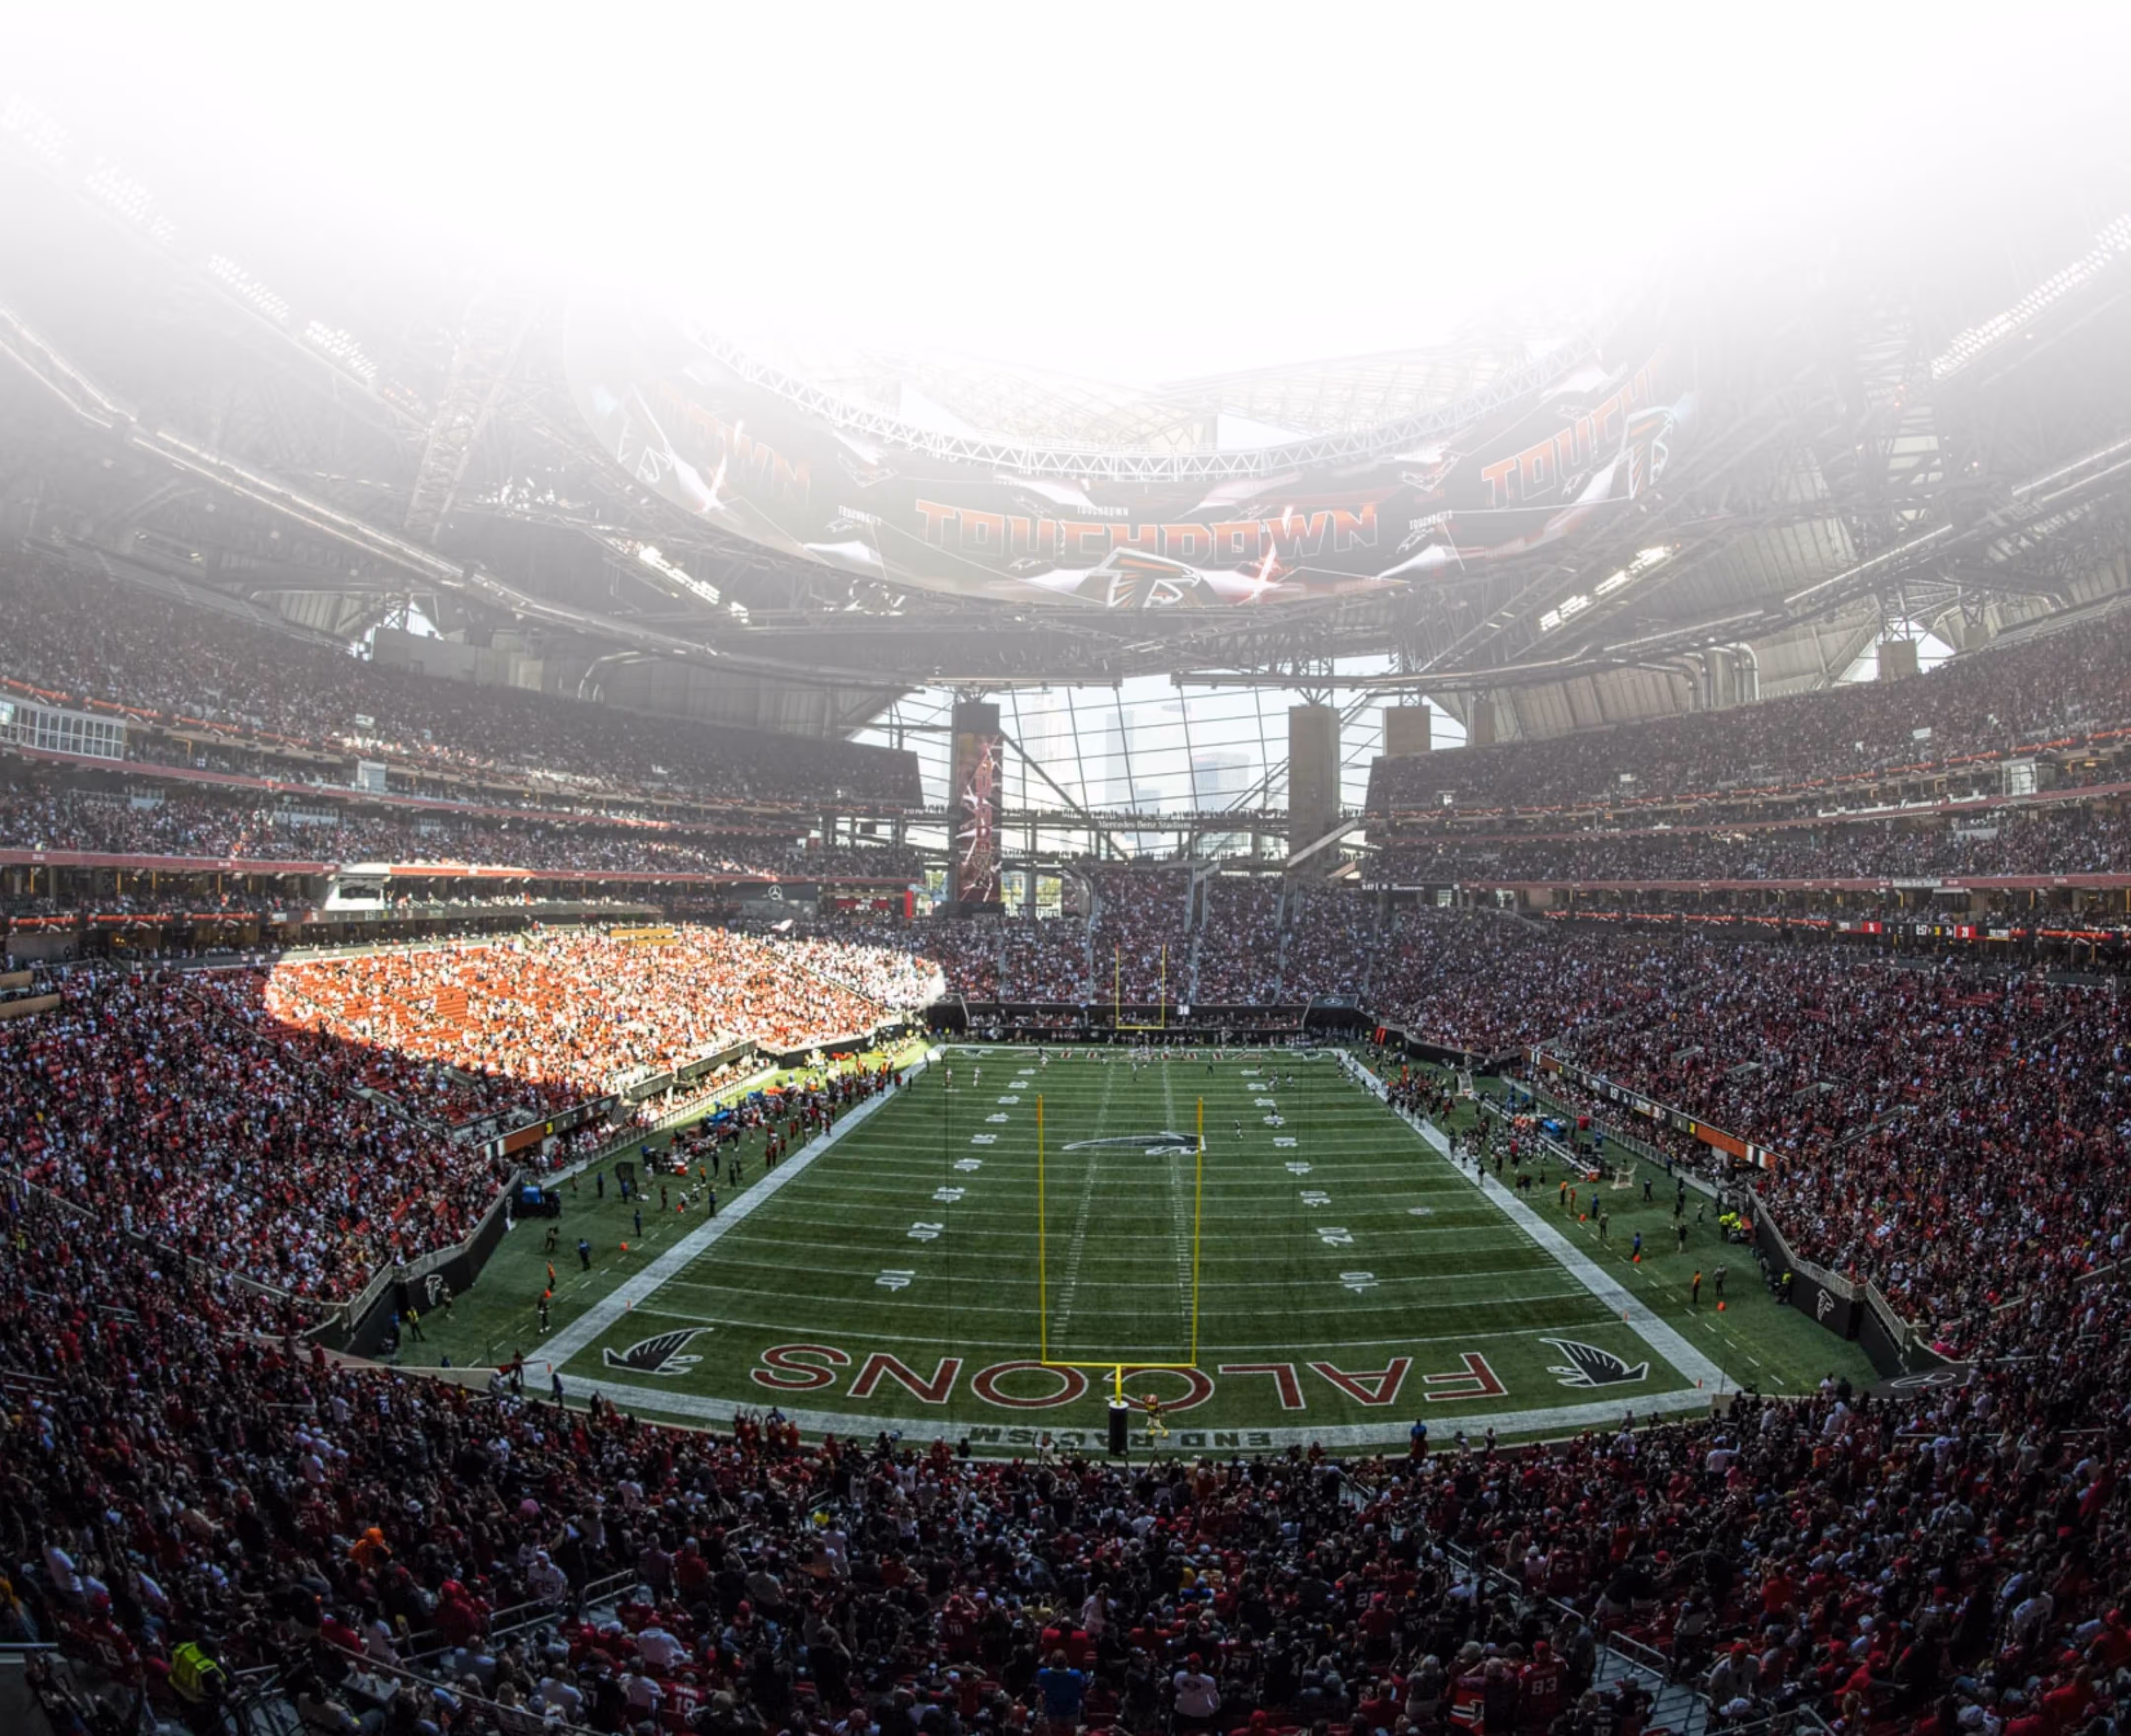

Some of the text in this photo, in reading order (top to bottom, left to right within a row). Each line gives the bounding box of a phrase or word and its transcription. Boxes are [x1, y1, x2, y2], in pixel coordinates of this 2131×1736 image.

[915, 499, 1378, 563] TOUCHDOWN
[751, 1343, 1508, 1412] FALCONS
[1181, 1433, 1272, 1448] END
[1532, 1677, 1557, 1696] 83
